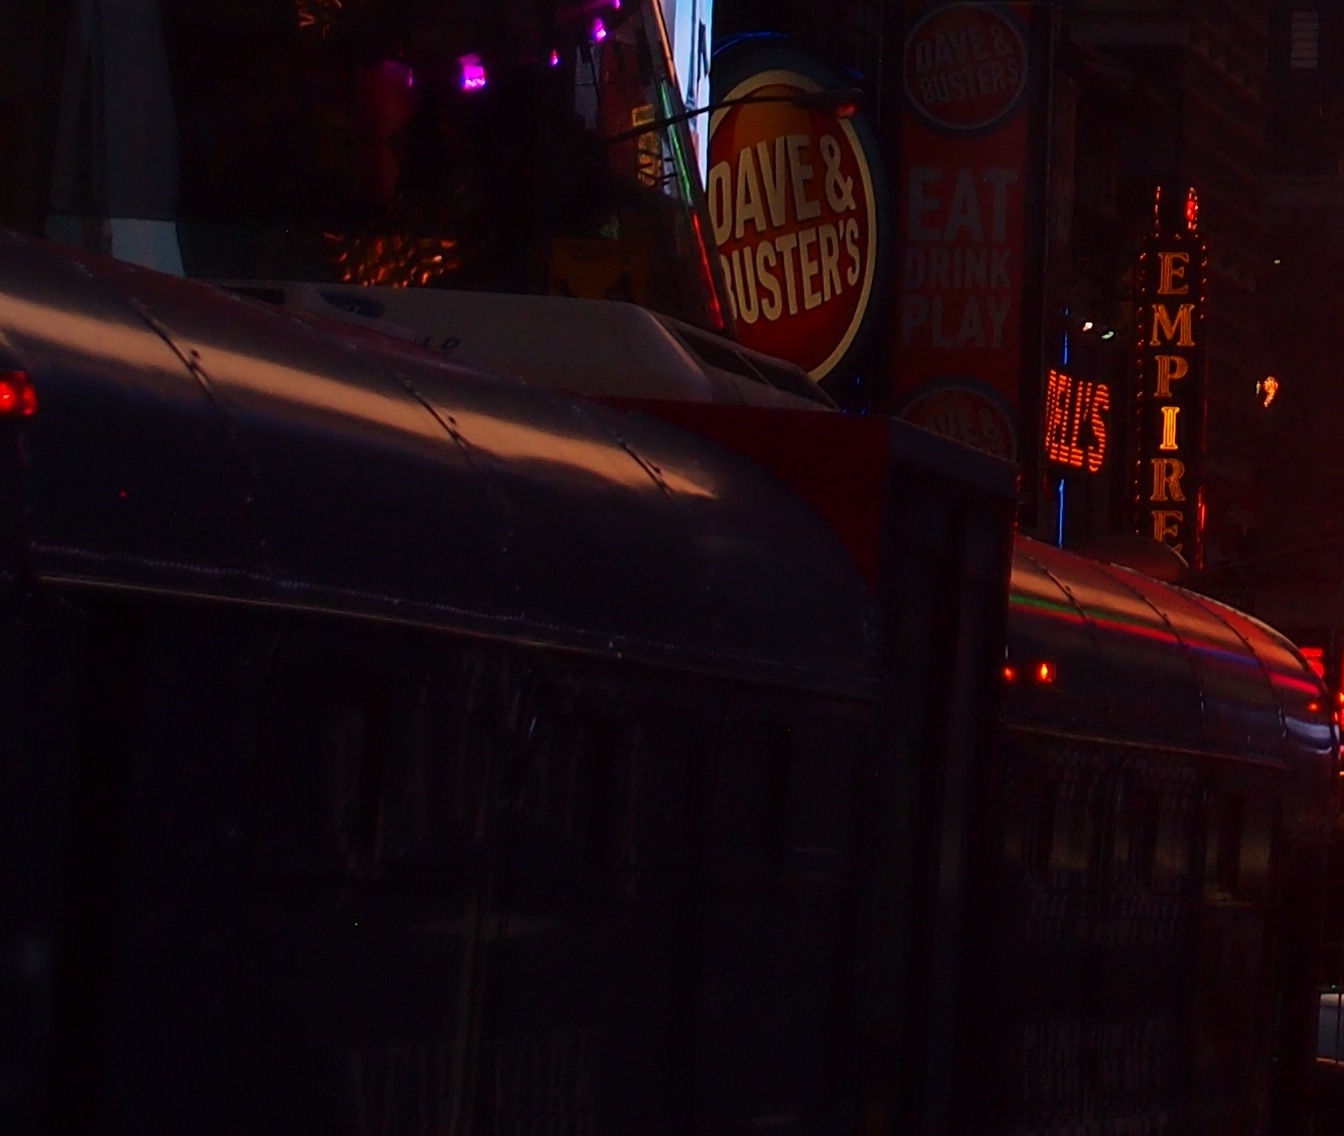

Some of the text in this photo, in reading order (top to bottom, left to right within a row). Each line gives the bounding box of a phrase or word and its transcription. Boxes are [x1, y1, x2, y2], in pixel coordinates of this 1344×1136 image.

[914, 27, 987, 75] DAVE
[707, 132, 813, 238] DAVE
[823, 135, 858, 210] &
[905, 166, 1020, 244] EAT
[719, 222, 862, 324] BUSTER'S
[904, 245, 1014, 292] DRINK
[900, 294, 1014, 351] PLAY
[1148, 250, 1197, 544] EMPIRE
